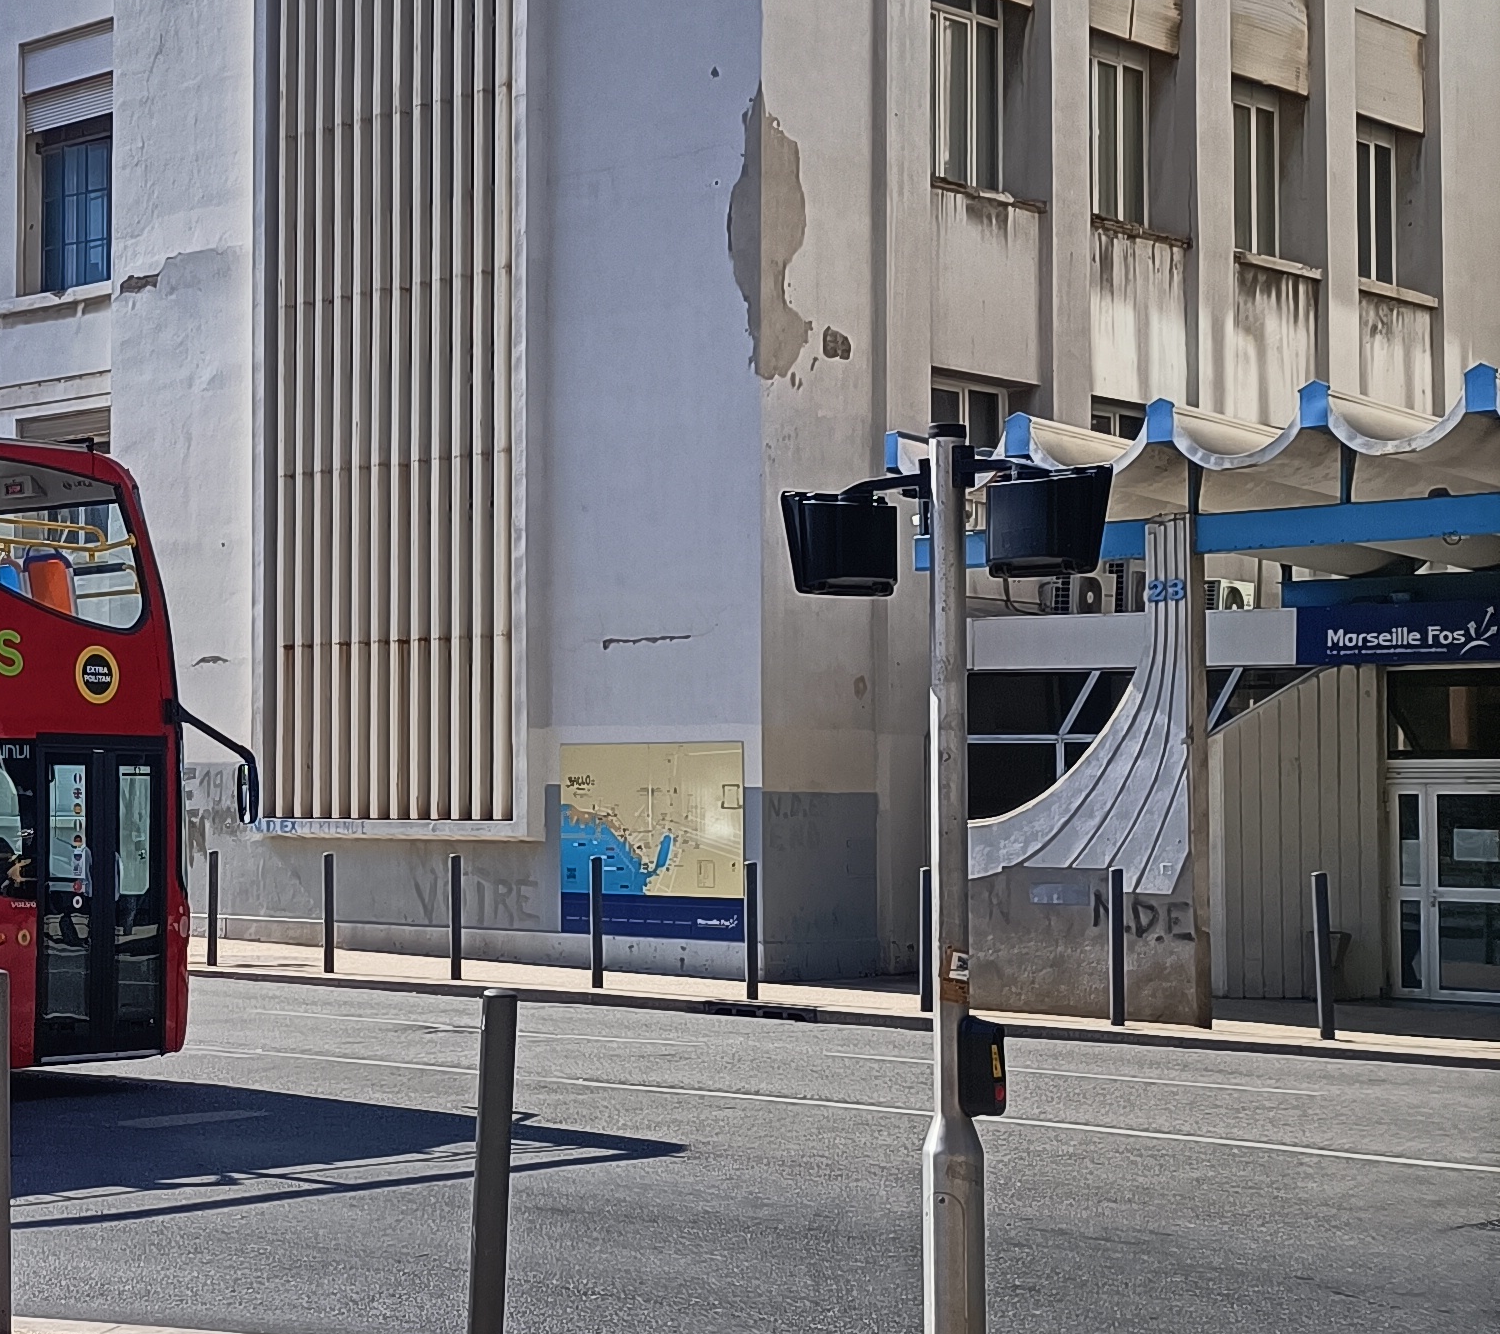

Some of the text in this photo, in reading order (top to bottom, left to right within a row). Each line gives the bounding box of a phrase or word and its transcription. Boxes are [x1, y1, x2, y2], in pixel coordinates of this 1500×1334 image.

[1148, 578, 1186, 603] 23
[1327, 626, 1466, 647] Marseille Fos
[11, 901, 37, 909] VOLVO
